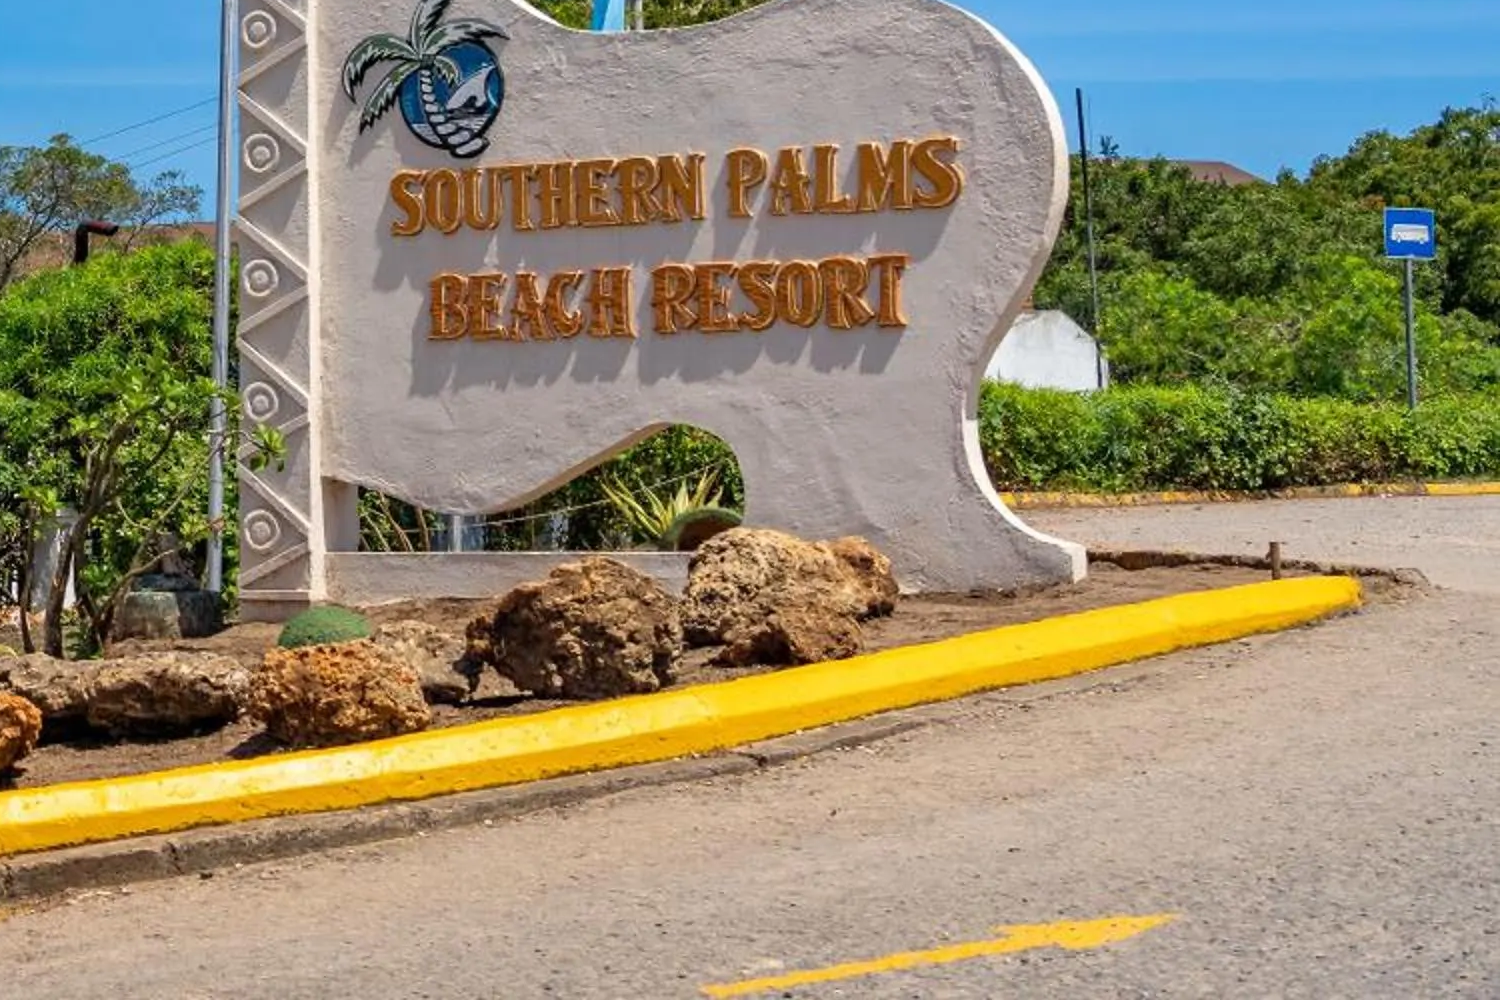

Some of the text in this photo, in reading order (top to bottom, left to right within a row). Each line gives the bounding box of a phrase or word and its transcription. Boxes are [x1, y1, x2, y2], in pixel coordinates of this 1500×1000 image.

[388, 137, 965, 236] SOUTHERN PALMS
[428, 253, 911, 343] BEACH RESORT
